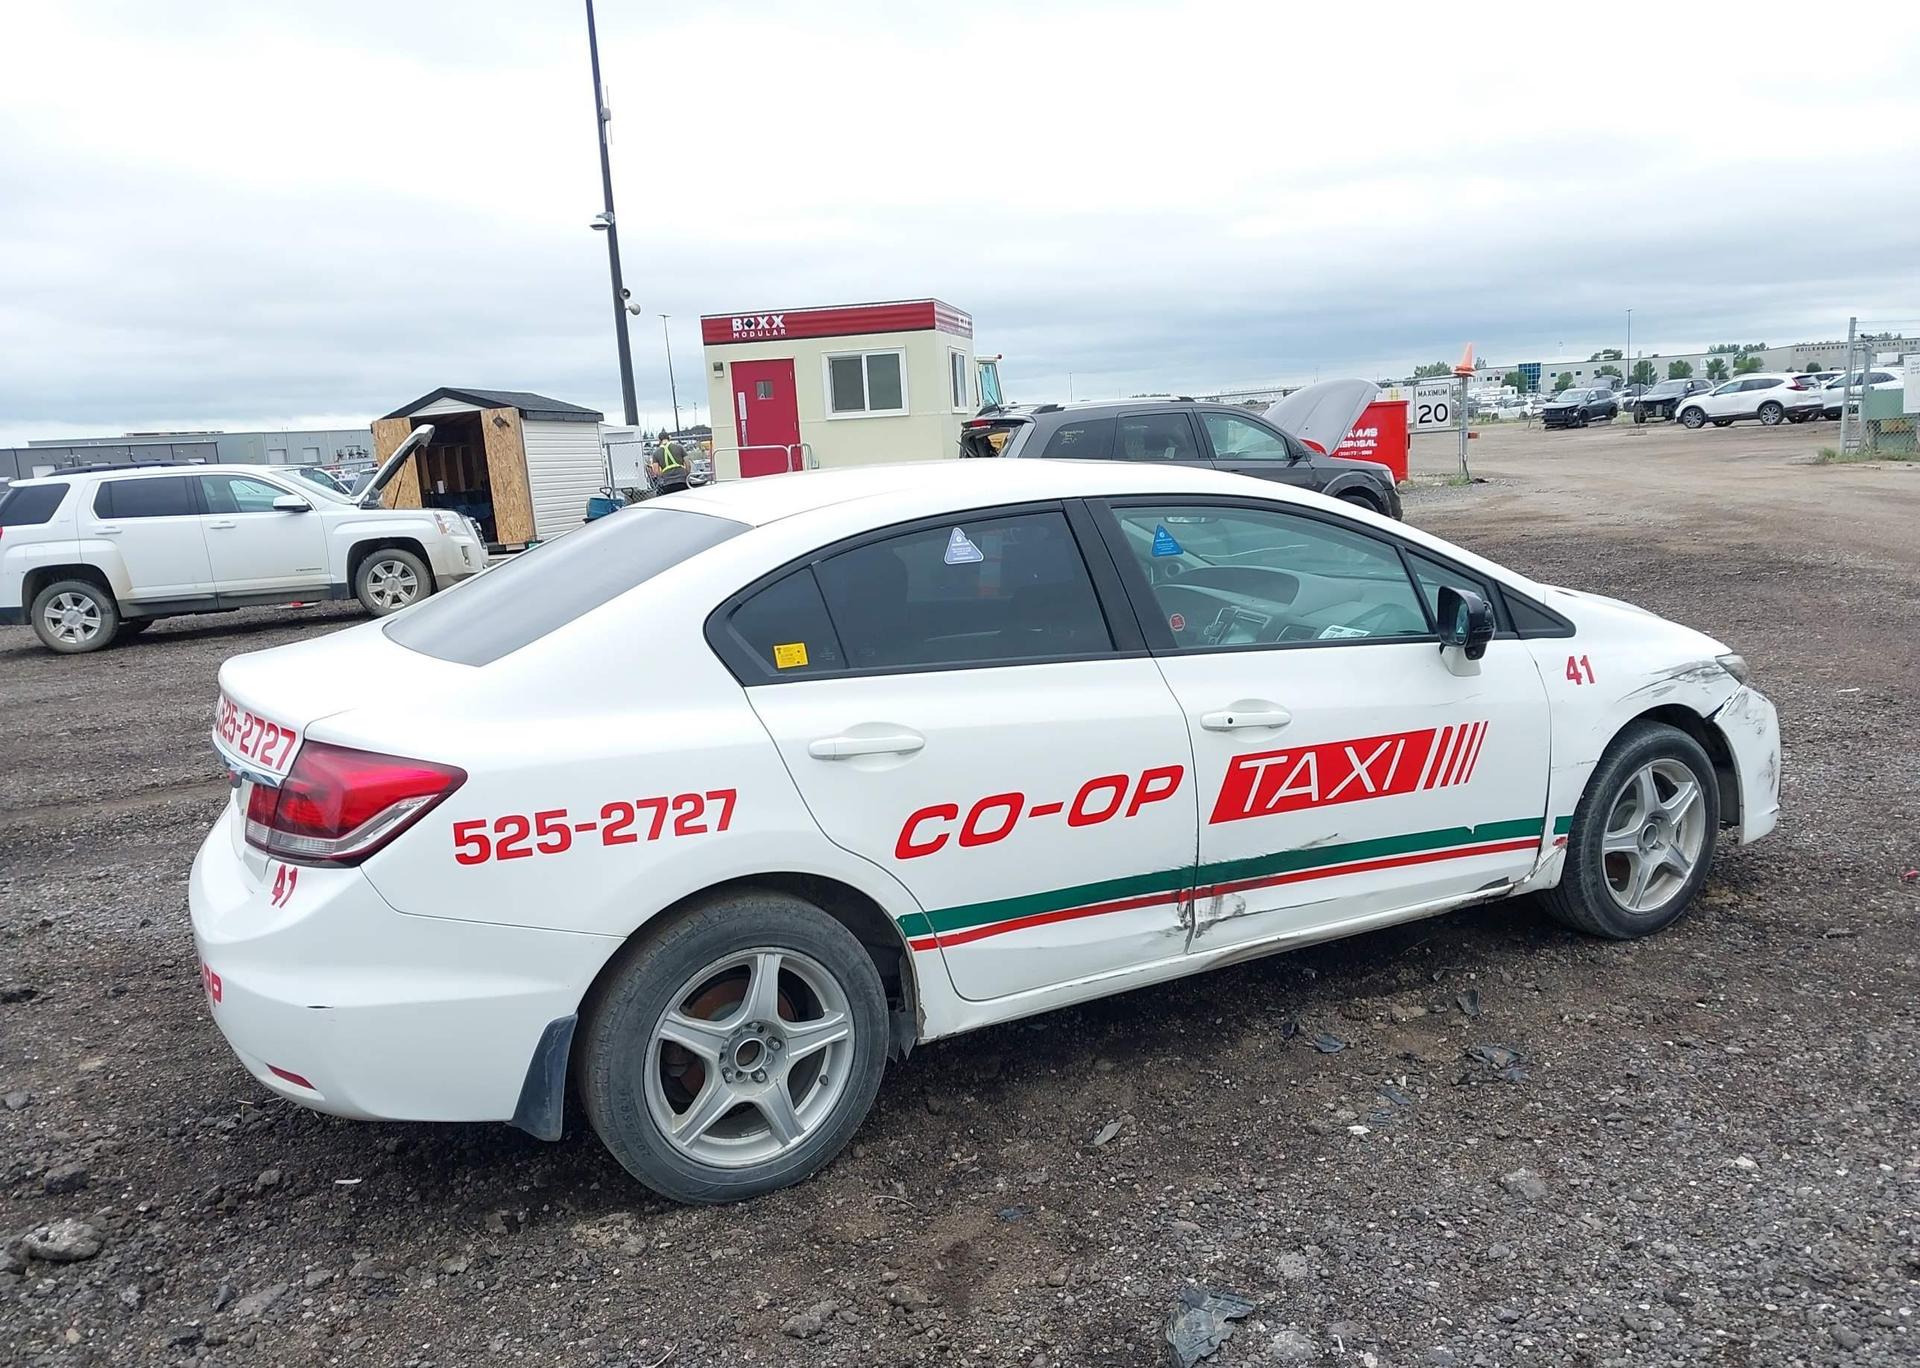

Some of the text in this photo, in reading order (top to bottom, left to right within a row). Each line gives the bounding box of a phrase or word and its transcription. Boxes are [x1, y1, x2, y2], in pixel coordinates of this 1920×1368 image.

[733, 329, 786, 339] MODULAR
[1417, 388, 1447, 397] MAXIMUM
[1418, 403, 1448, 423] 20
[1566, 654, 1596, 685] 41
[1239, 738, 1406, 814] TAXI
[452, 788, 738, 866] 525-2727
[894, 764, 1185, 860] CO-OP
[272, 864, 298, 909] 41
